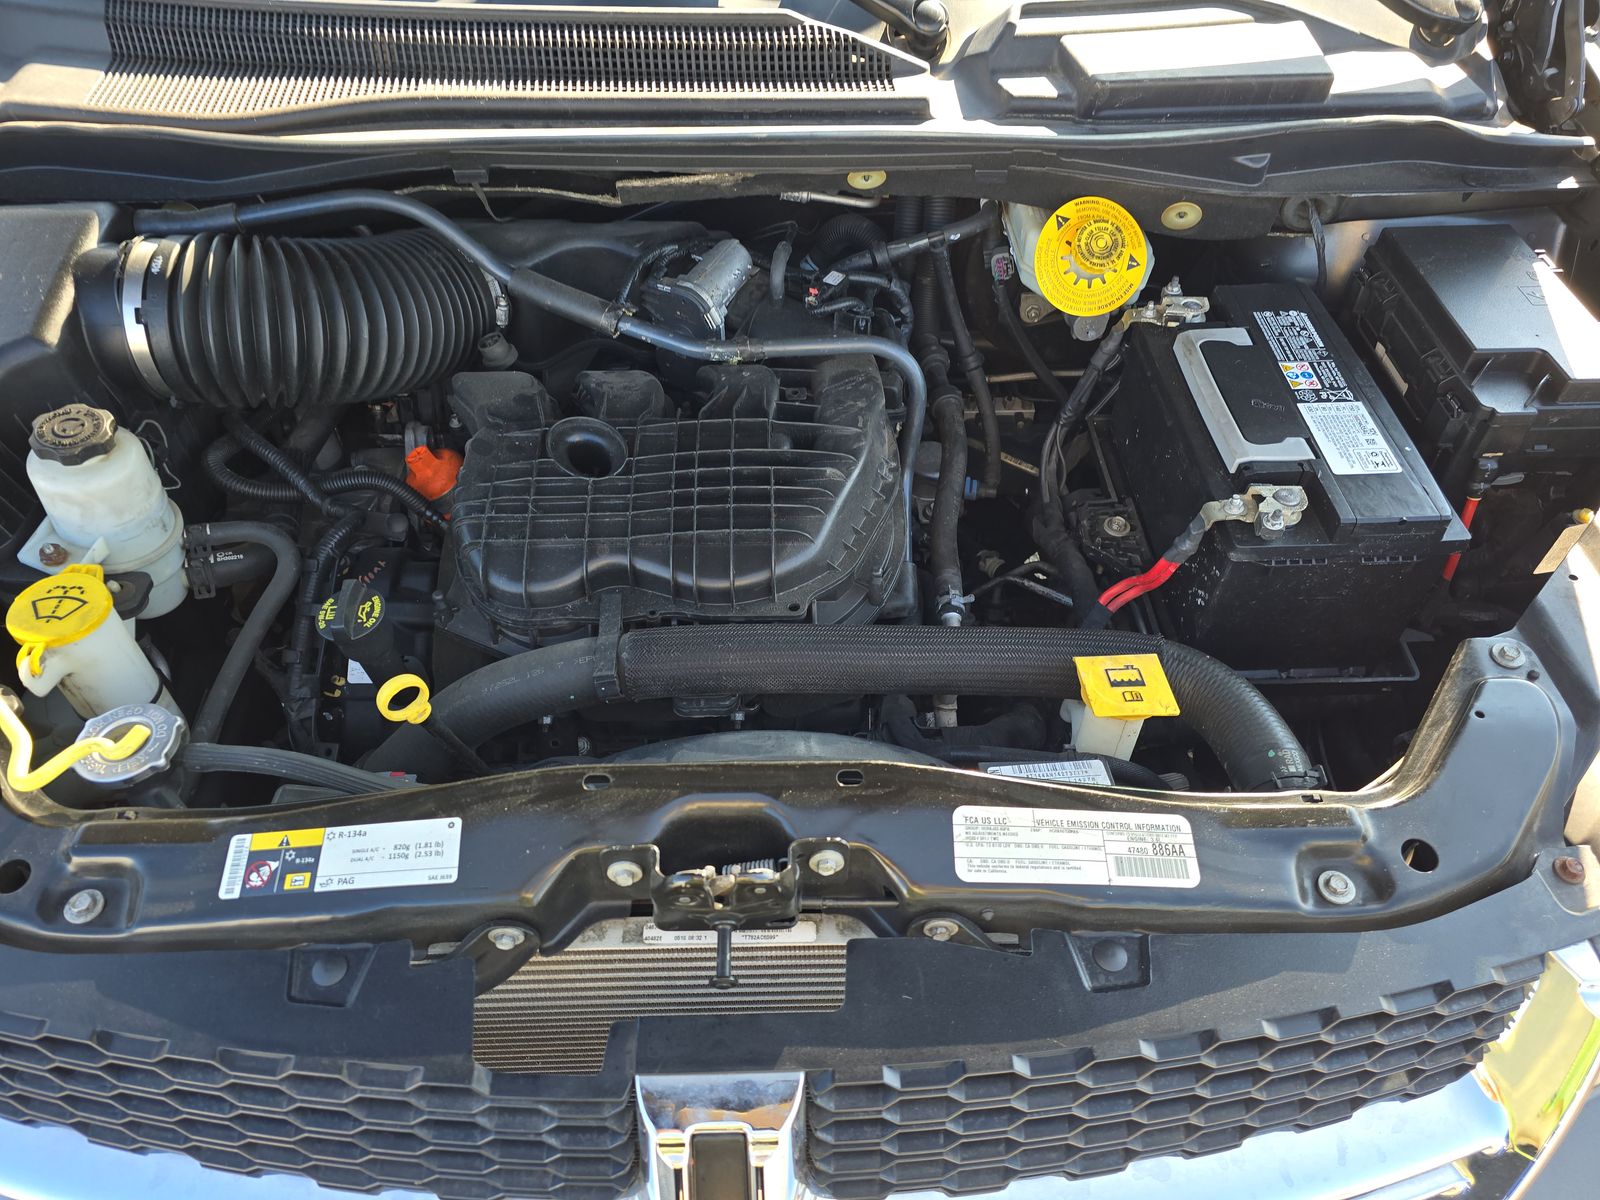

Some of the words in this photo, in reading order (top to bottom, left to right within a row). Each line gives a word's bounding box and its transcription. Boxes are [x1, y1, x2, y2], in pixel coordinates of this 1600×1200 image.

[1101, 202, 1116, 211] CLEAN
[322, 598, 334, 609] SAE
[371, 595, 381, 618] ENGINE
[318, 610, 326, 629] 5W-20
[363, 617, 377, 628] OIL
[964, 816, 979, 824] FCA
[981, 816, 992, 825] US
[994, 817, 1008, 825] LLC
[1036, 819, 1064, 827] VEHICLE
[1067, 820, 1100, 829] EMISSION
[1101, 821, 1132, 831] CONTROL
[1134, 823, 1182, 832] INFORMATION
[338, 830, 367, 839] R-134a
[414, 842, 433, 850] (1.81
[434, 841, 444, 849] lb)
[1151, 842, 1186, 857] 886AA
[388, 852, 410, 860] 1150g
[414, 850, 433, 859] (2.53
[434, 849, 444, 857] lb)
[337, 876, 355, 886] PAG
